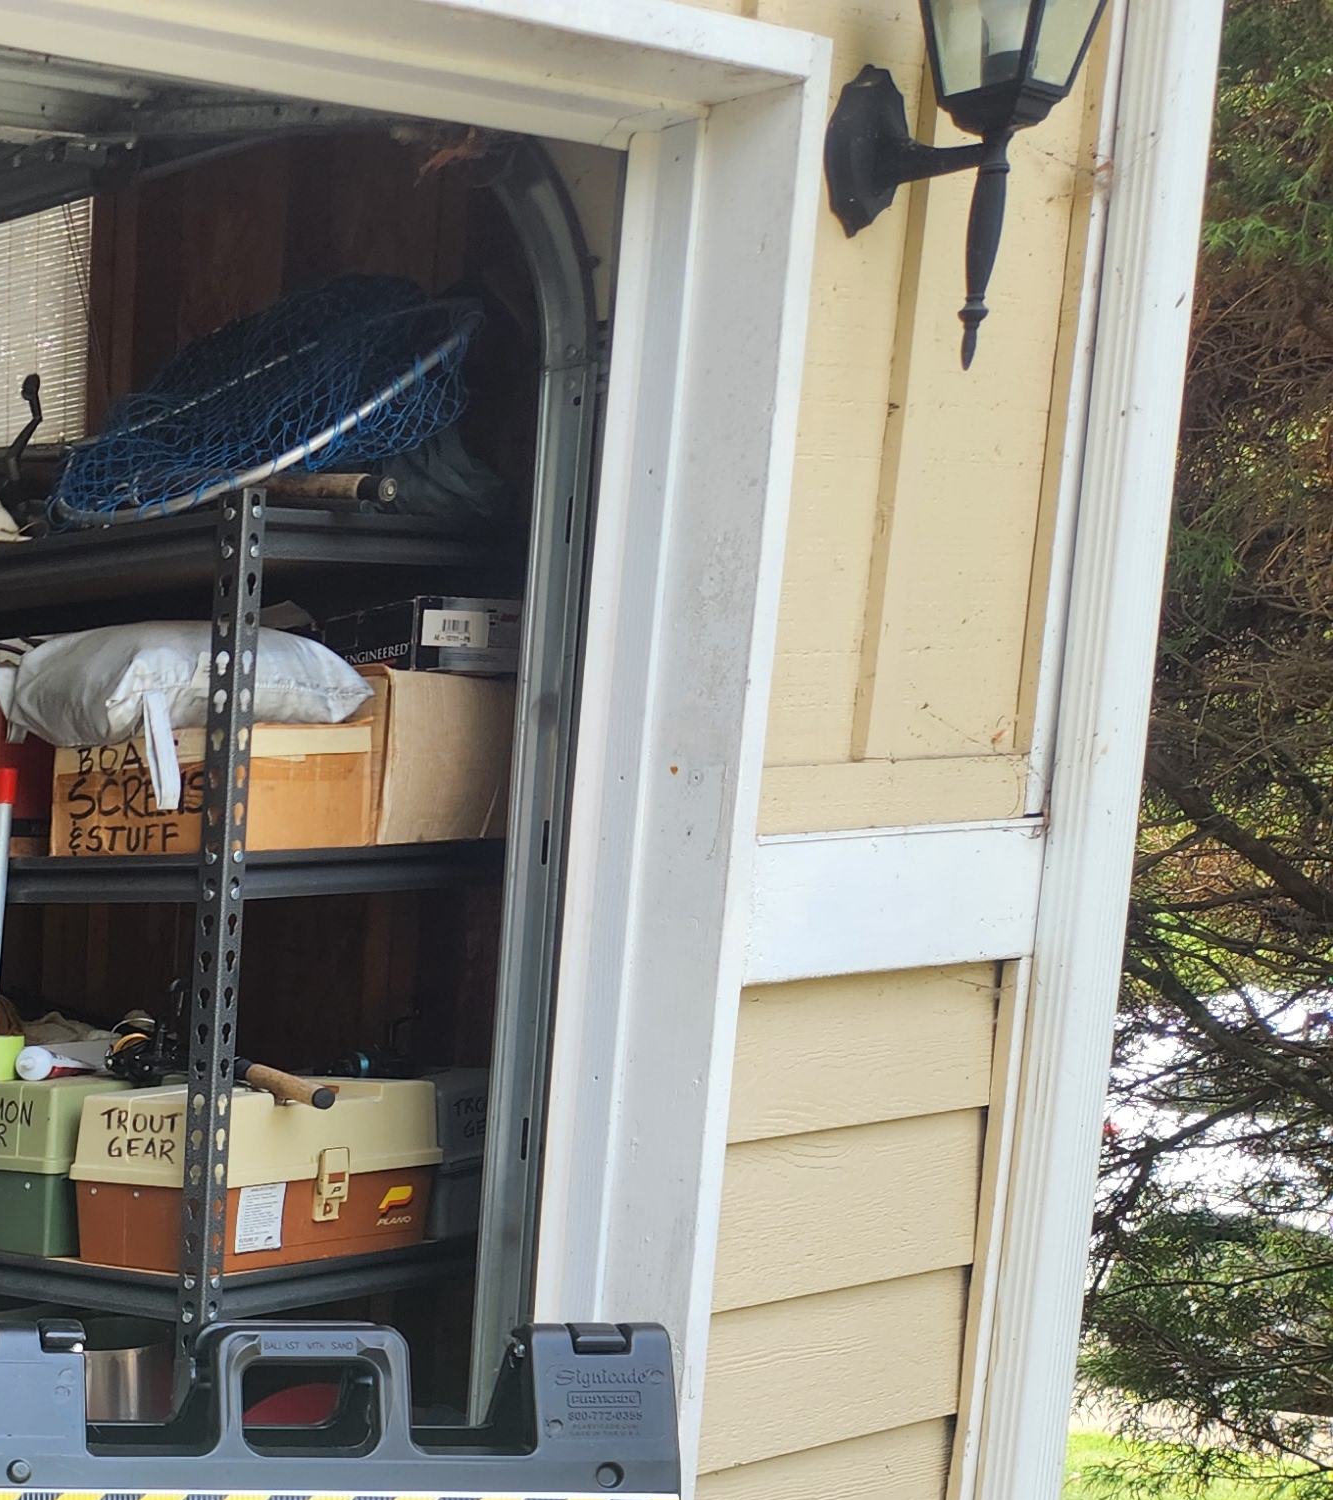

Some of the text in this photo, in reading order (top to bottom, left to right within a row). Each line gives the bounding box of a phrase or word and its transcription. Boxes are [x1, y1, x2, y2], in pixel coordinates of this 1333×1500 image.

[344, 642, 410, 665] ENGINEERED
[77, 743, 147, 776] BOA
[68, 774, 203, 819] SCRES
[85, 822, 180, 853] STUFF
[100, 1106, 184, 1134] TROUT
[106, 1136, 177, 1166] GEAR
[376, 1215, 412, 1227] PLANO
[263, 1341, 354, 1350] BALLAST WITH SAND
[555, 1368, 648, 1389] Signicade
[567, 1411, 643, 1421] 800-772-0355
